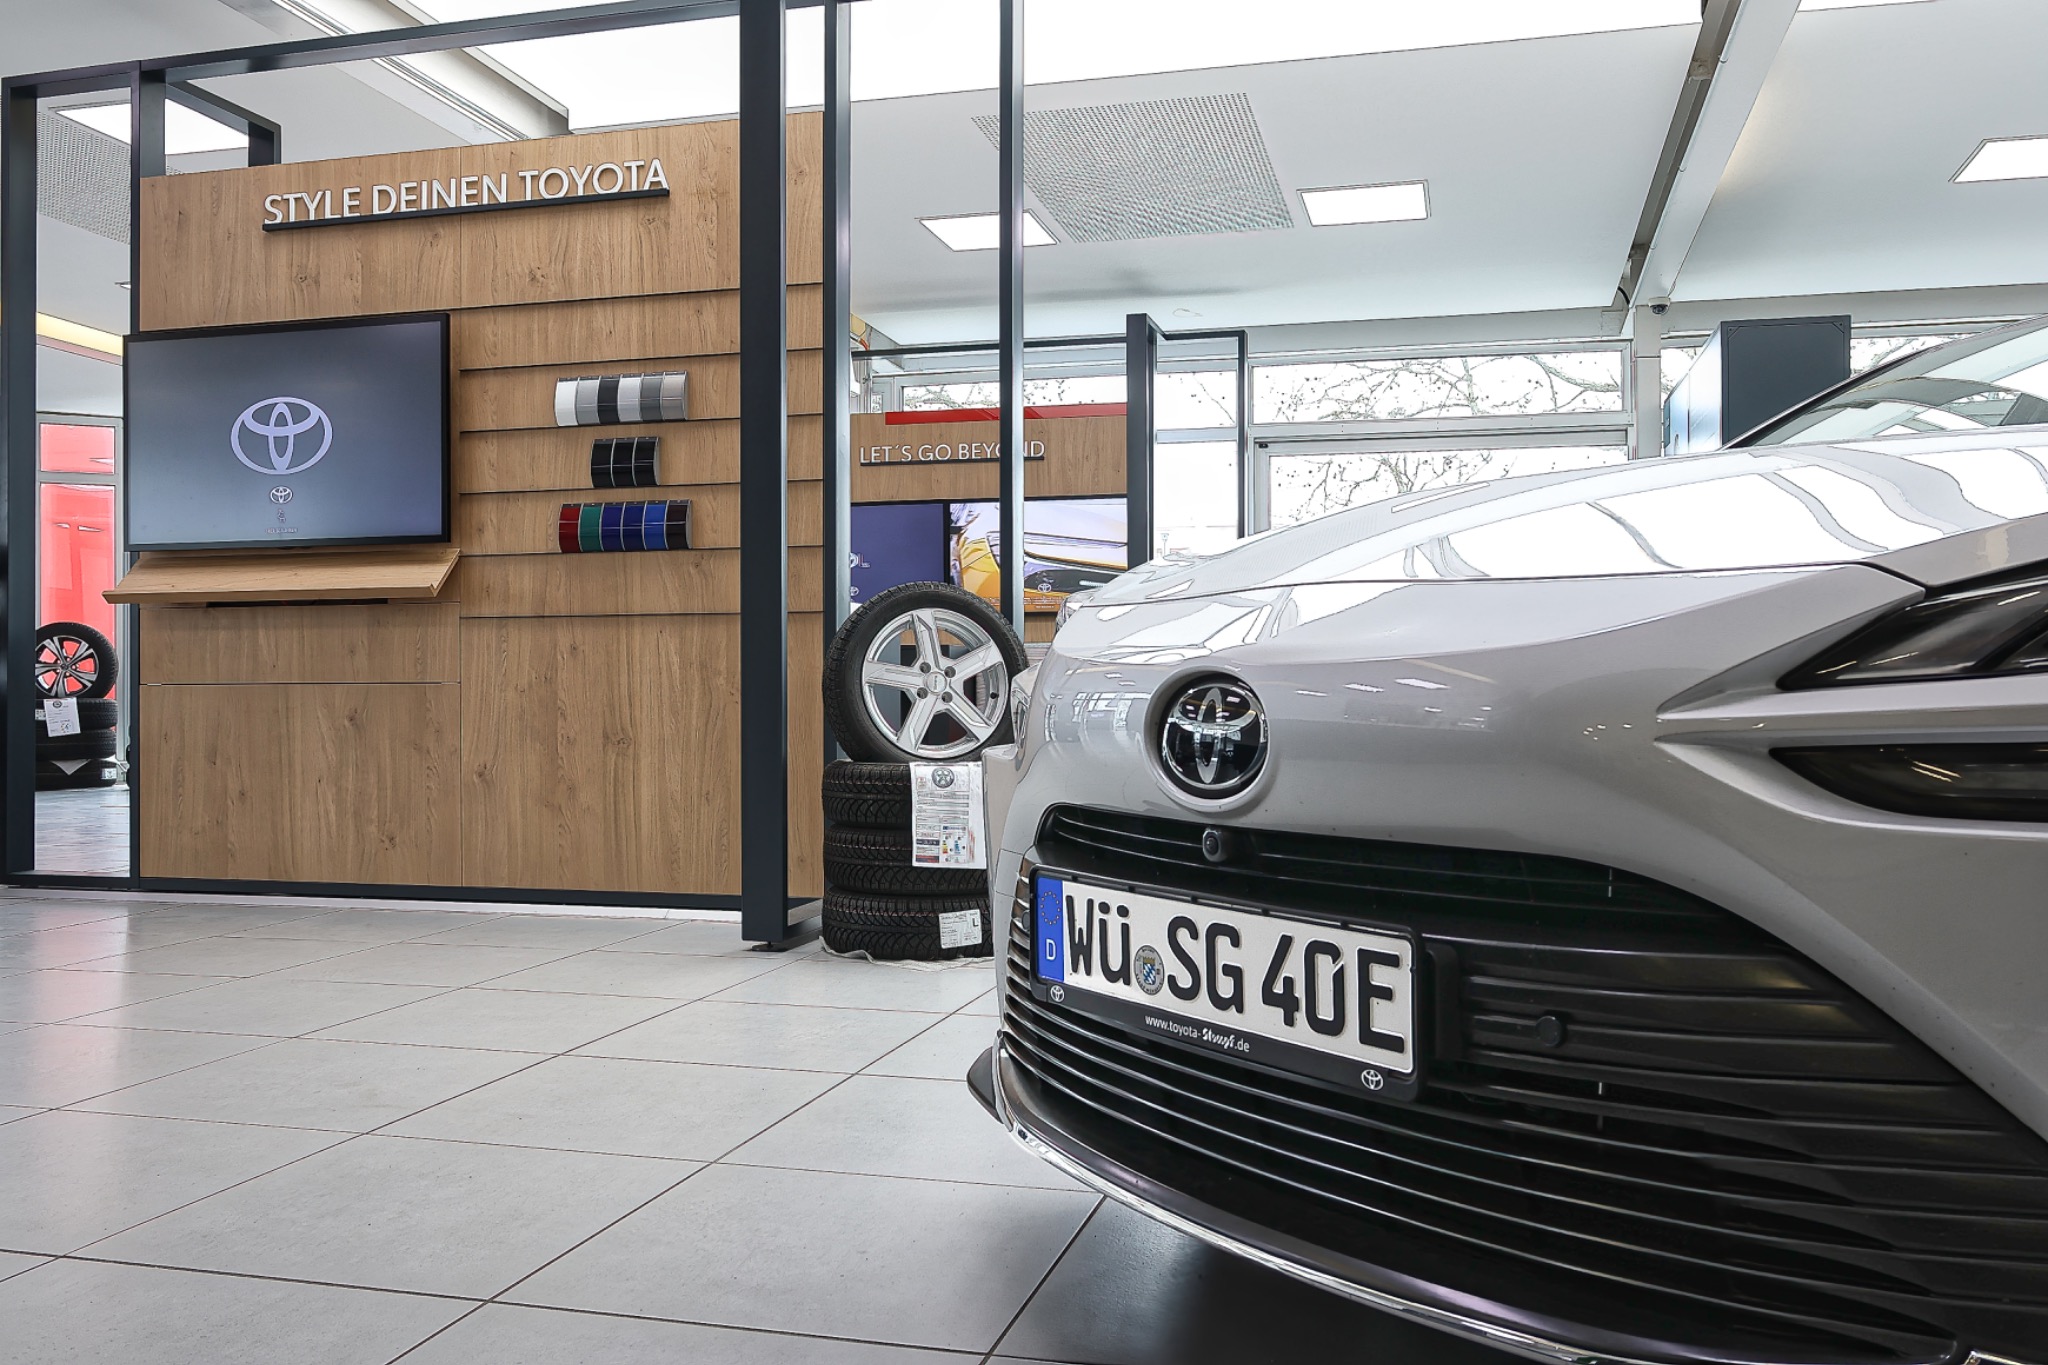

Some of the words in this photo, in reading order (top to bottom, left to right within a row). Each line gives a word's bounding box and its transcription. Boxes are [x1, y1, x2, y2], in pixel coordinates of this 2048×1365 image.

[263, 187, 361, 226] STYLE
[372, 173, 508, 215] DEINEN
[518, 158, 670, 202] TOYOTA
[918, 444, 951, 461] GO
[957, 440, 1046, 460] BEYD
[1045, 938, 1057, 961] D
[1065, 894, 1131, 986] WÜ
[1167, 915, 1244, 1014] SG
[1261, 933, 1405, 1054] 40E
